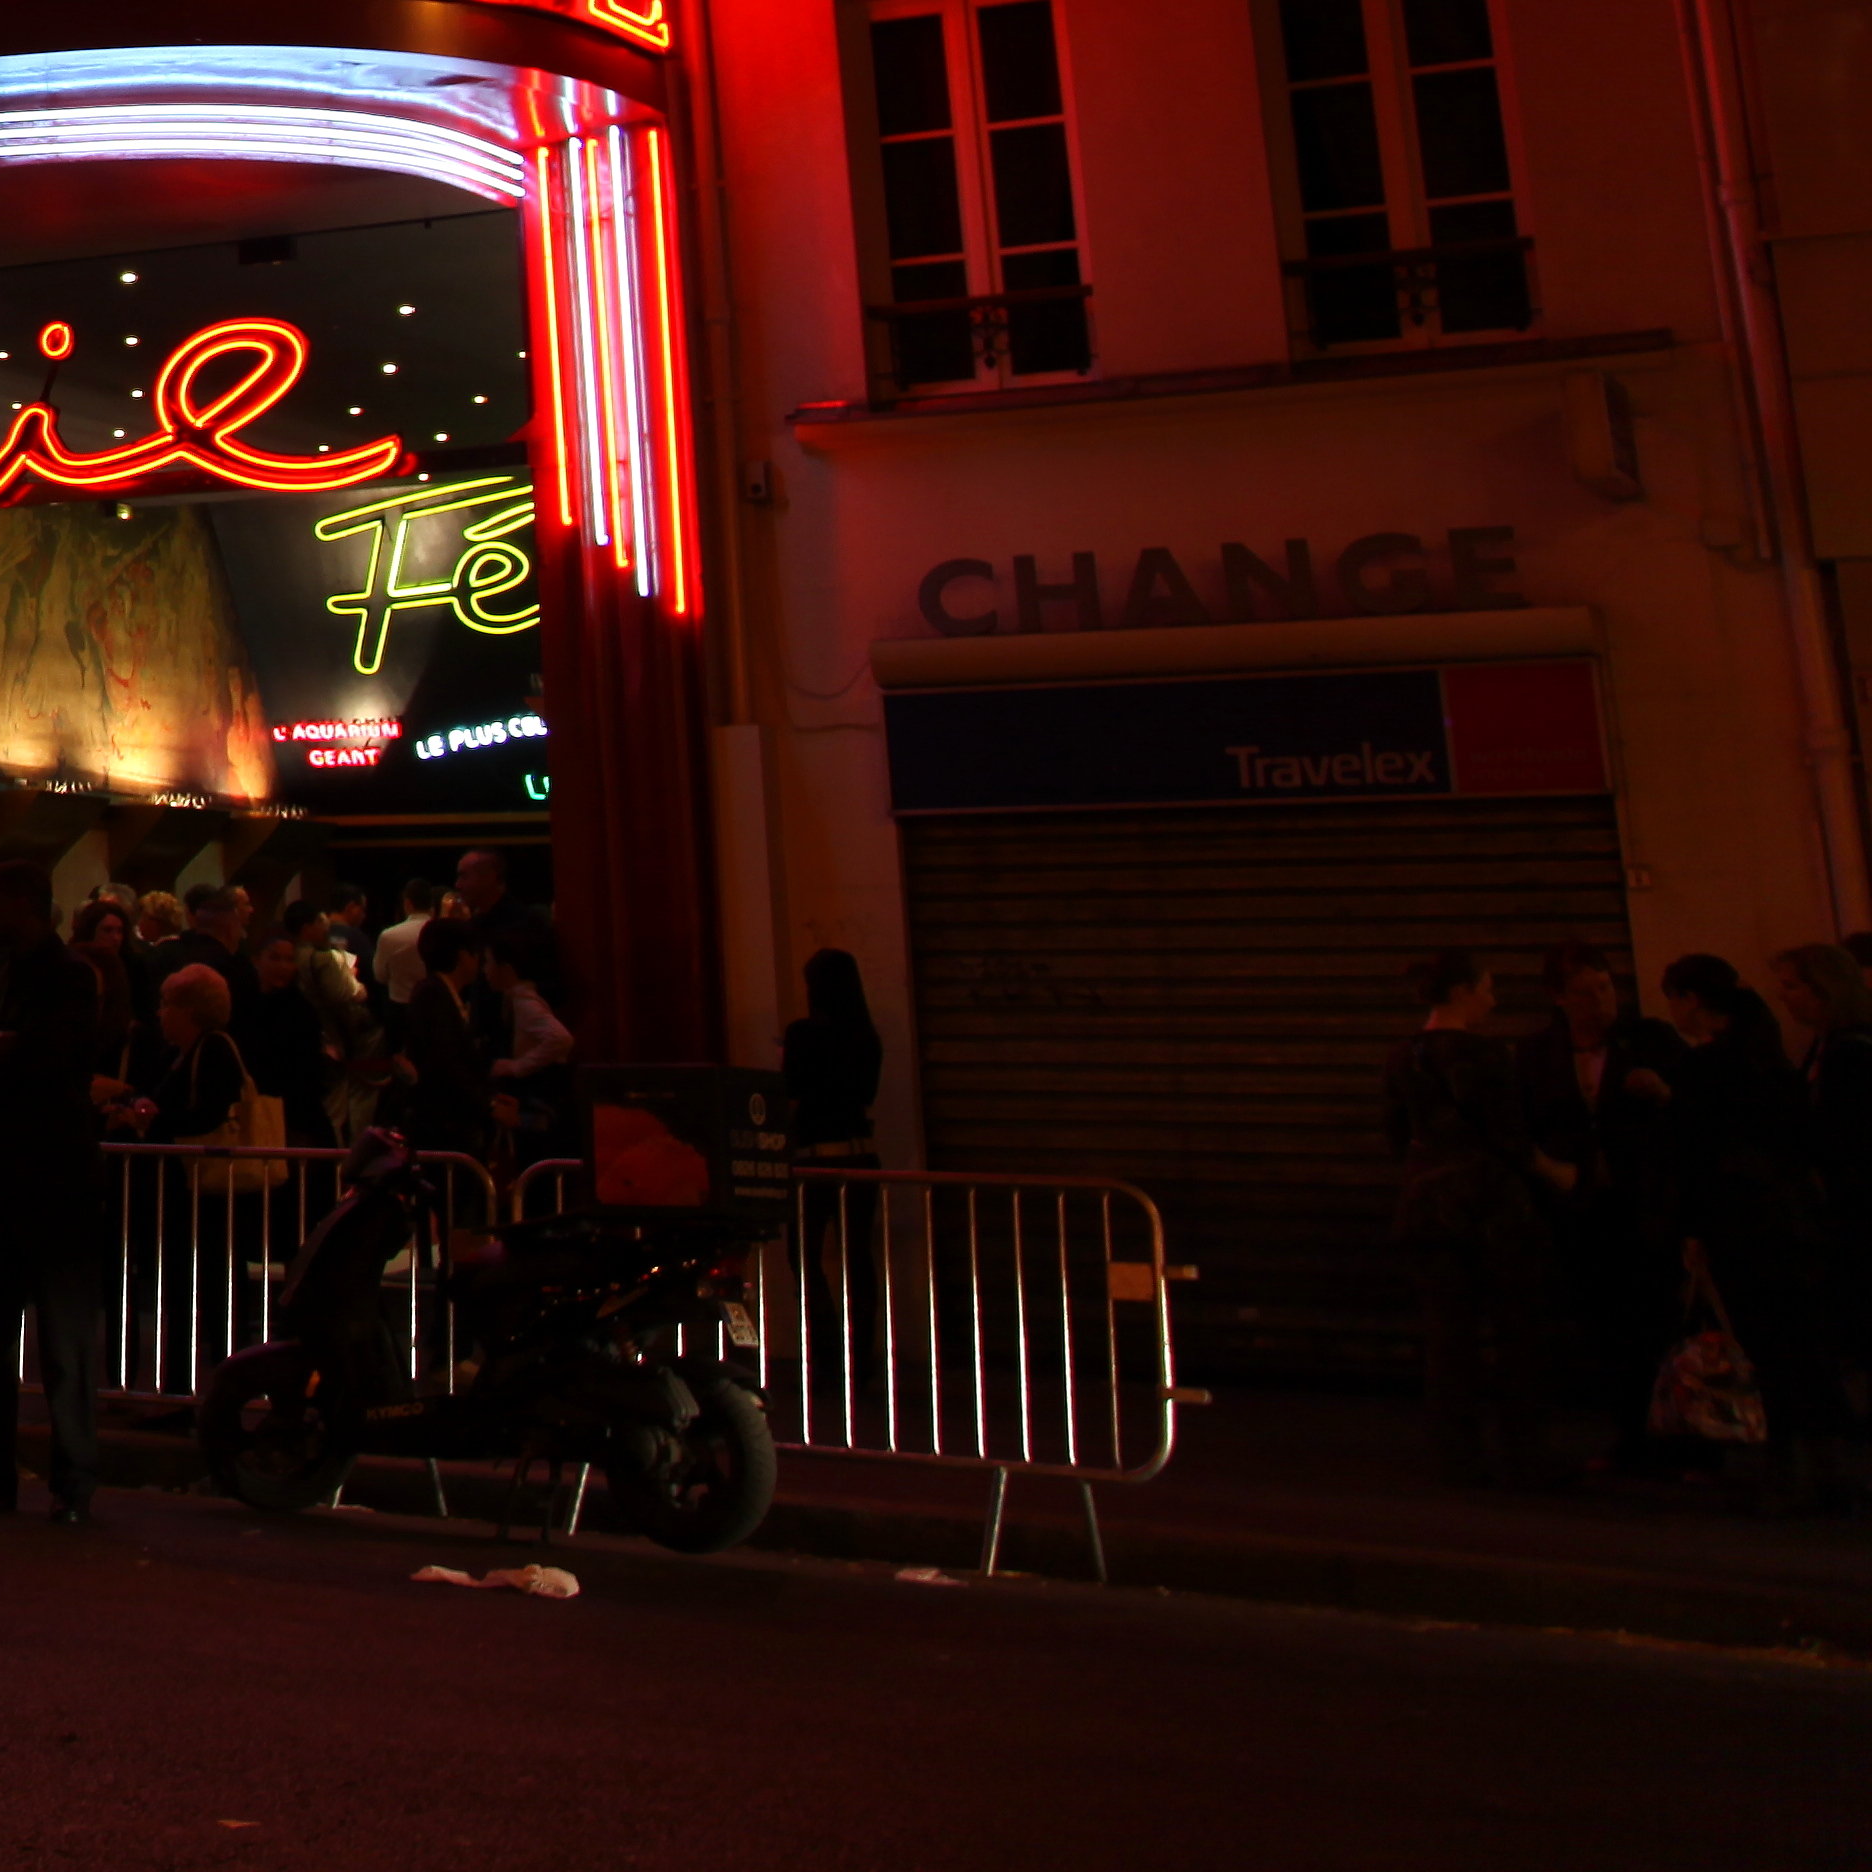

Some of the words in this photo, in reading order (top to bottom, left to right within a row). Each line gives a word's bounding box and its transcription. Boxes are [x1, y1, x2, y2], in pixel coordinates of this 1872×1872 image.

[917, 526, 1530, 638] CHANGE
[416, 733, 445, 760] LE
[447, 721, 508, 753] PLUS
[1224, 740, 1437, 790] Travelex
